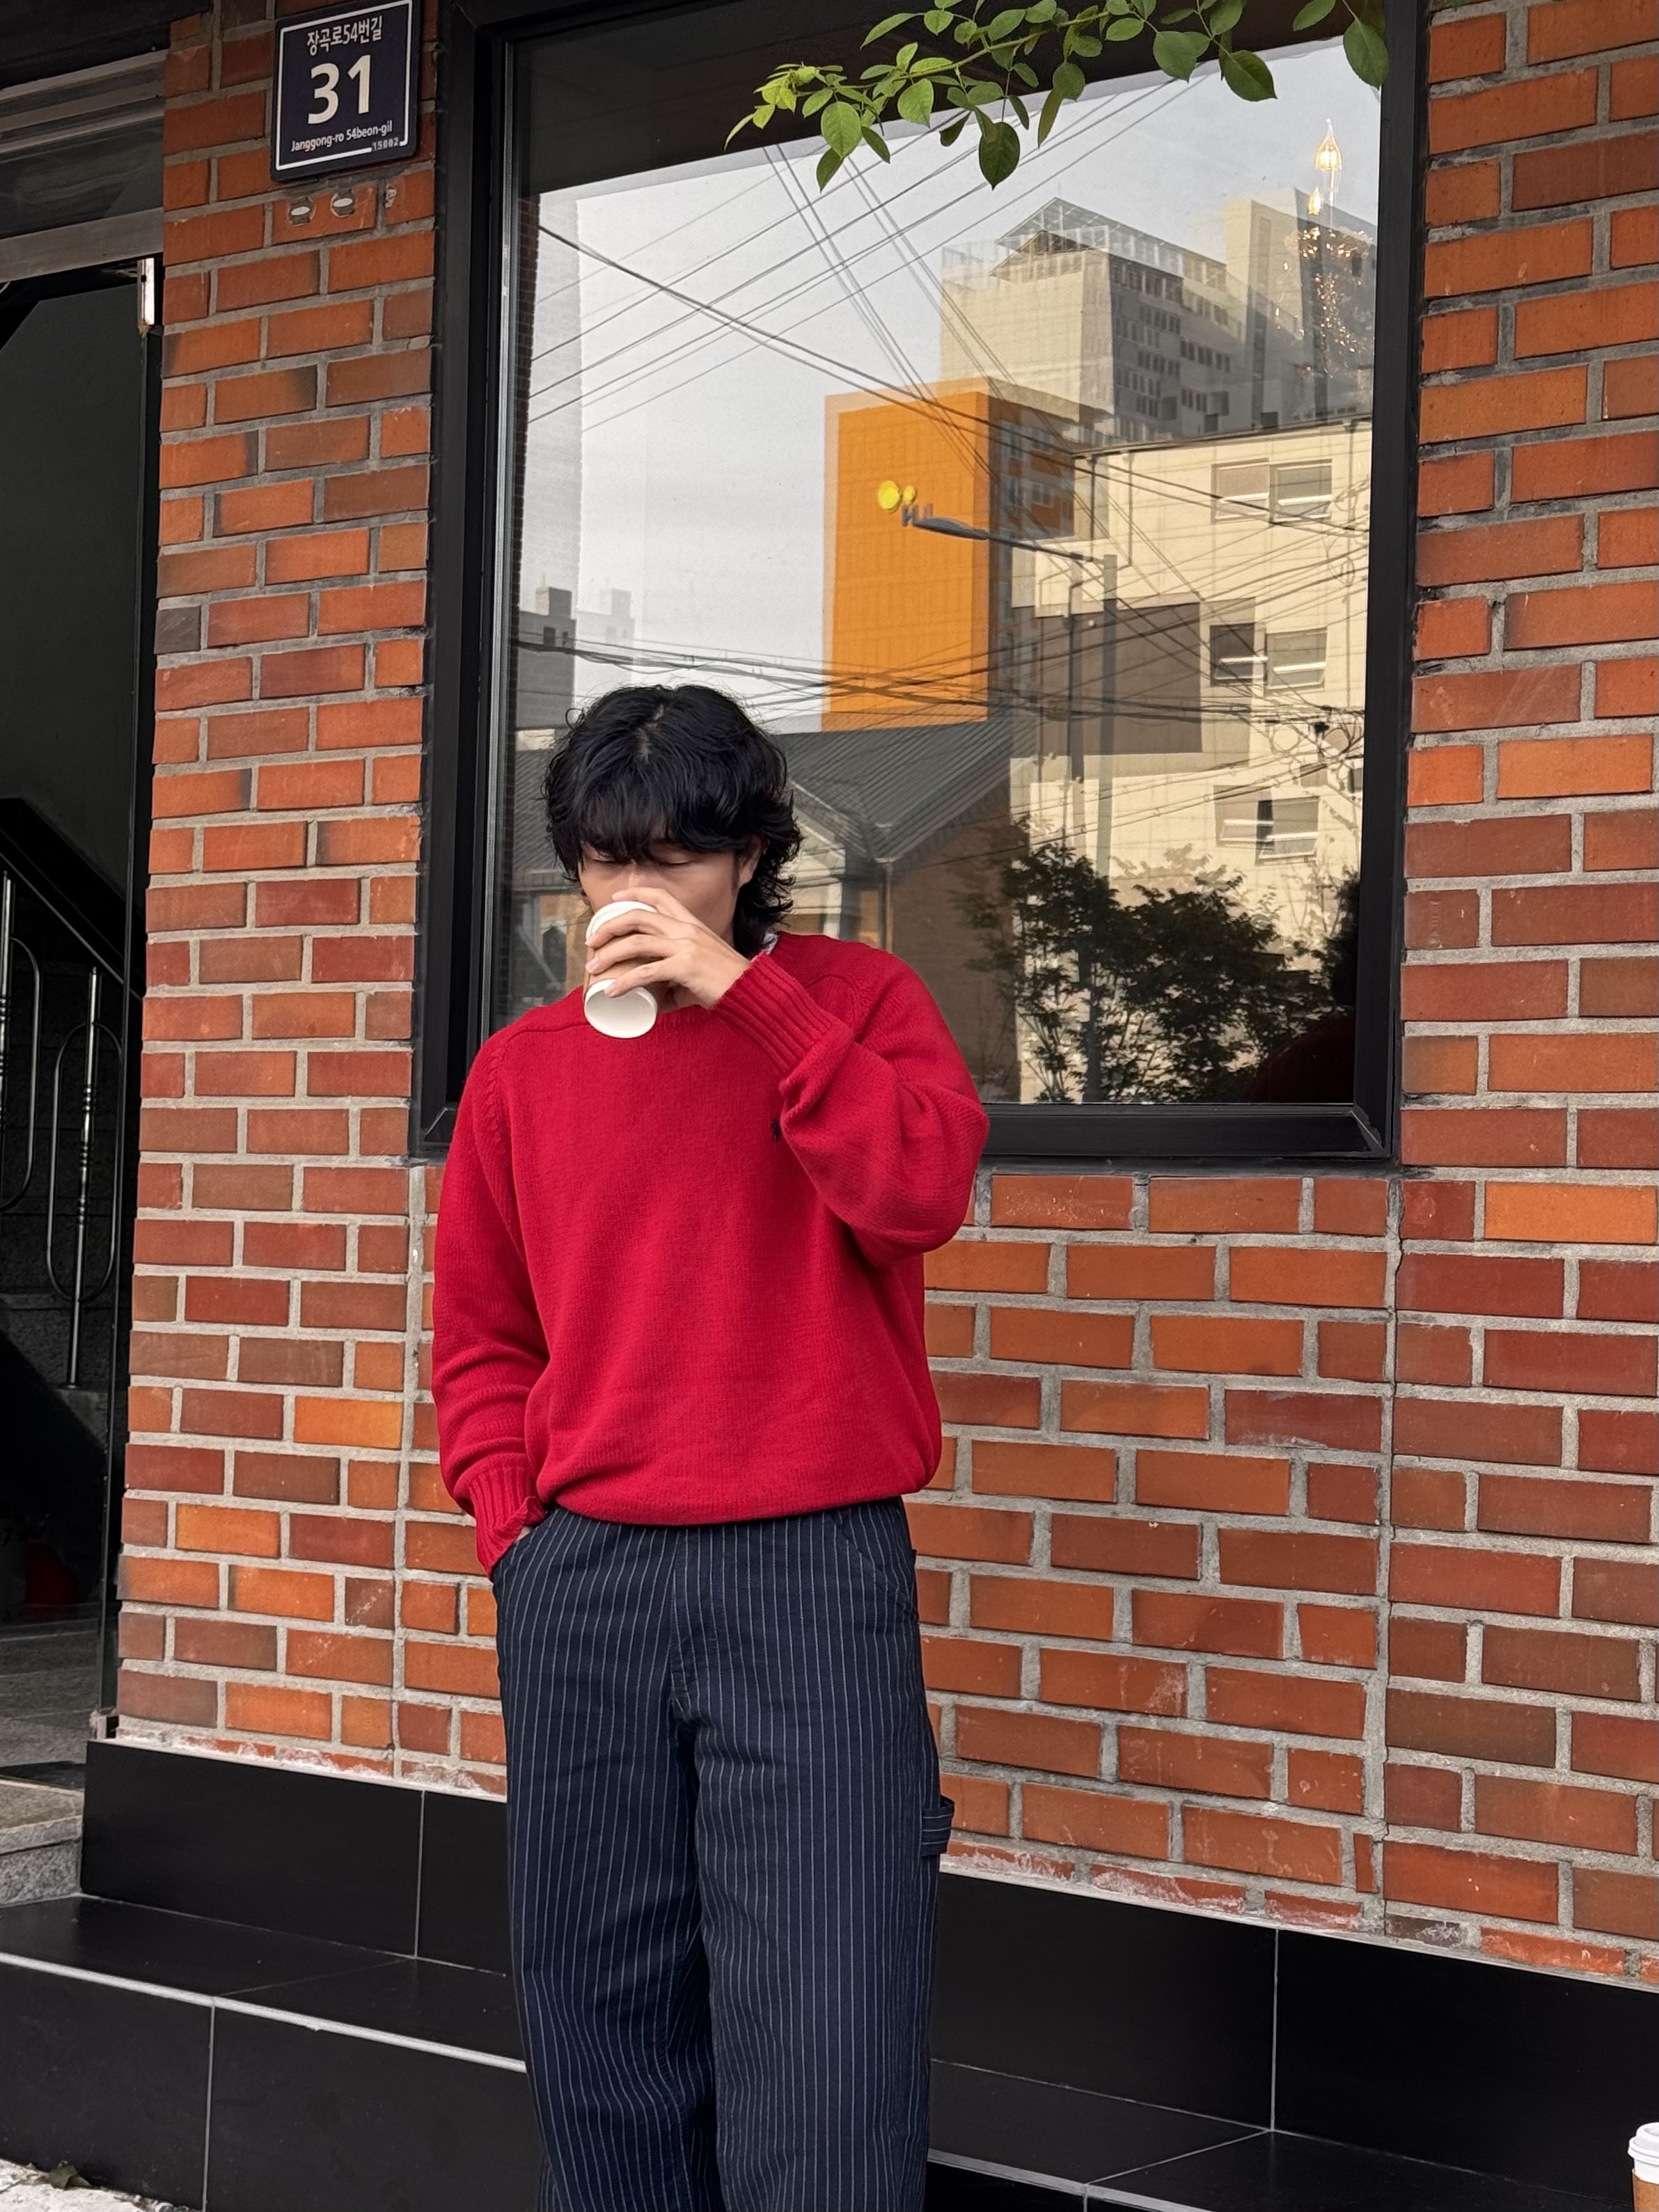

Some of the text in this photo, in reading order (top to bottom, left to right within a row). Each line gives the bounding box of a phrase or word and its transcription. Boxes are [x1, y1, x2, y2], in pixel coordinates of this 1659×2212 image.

[307, 15, 382, 56] 장곡로54번길
[308, 54, 371, 124] 31
[291, 120, 393, 152] Janggong-ro 54beon-gil
